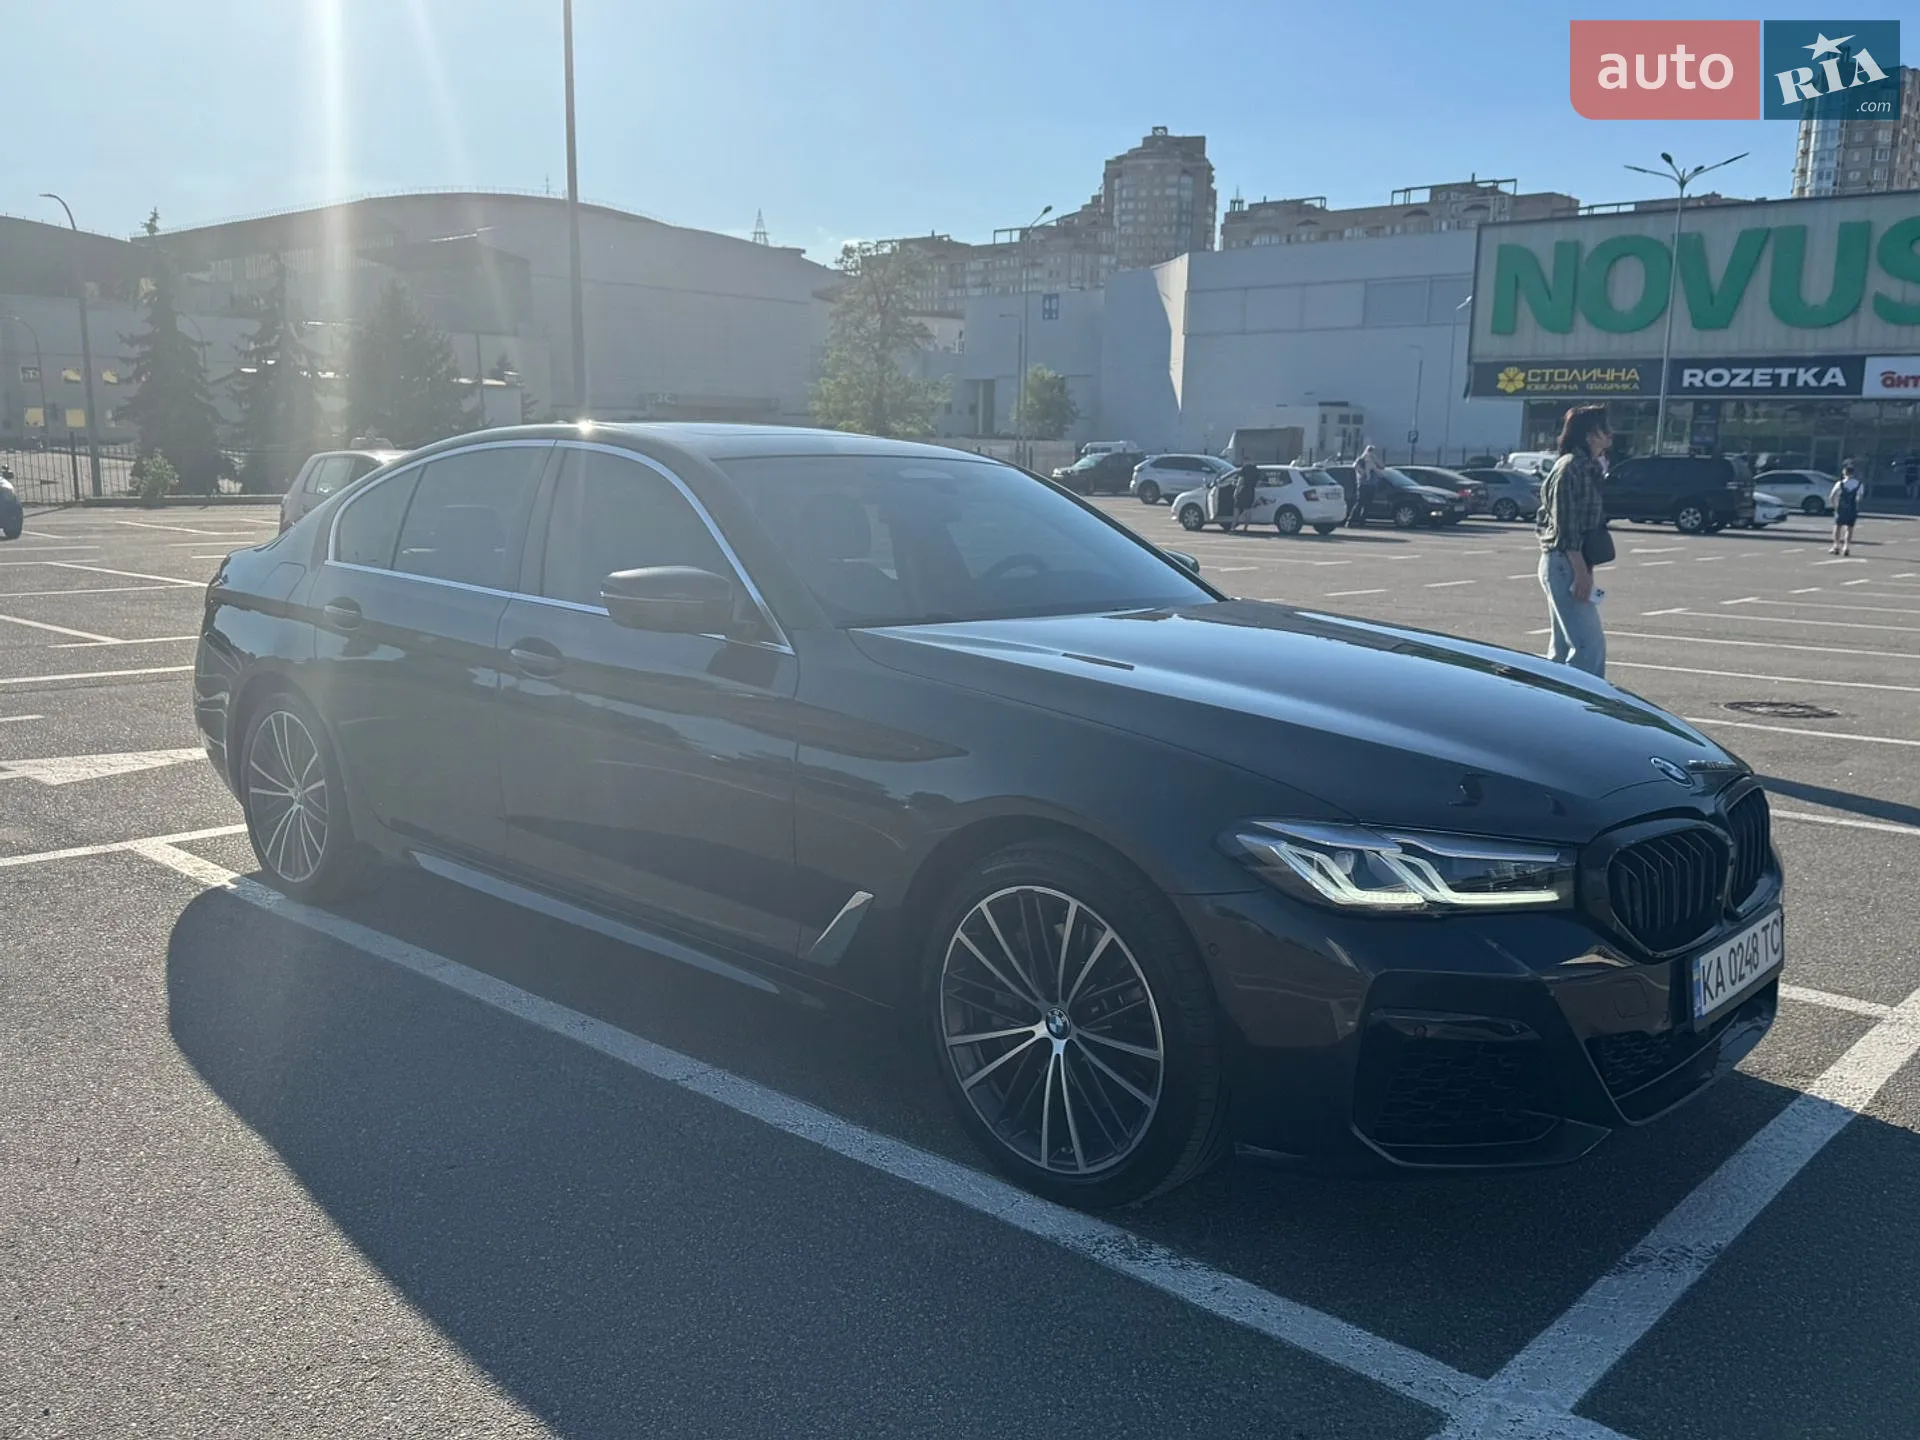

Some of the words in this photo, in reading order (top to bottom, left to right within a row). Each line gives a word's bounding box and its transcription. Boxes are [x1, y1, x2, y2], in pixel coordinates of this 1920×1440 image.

[1527, 367, 1640, 382] СТОЛИЧНА
[1682, 367, 1847, 388] ROZETKA
[1702, 956, 1725, 1006] KA
[1728, 932, 1759, 986] 0248
[1761, 918, 1780, 962] TC
